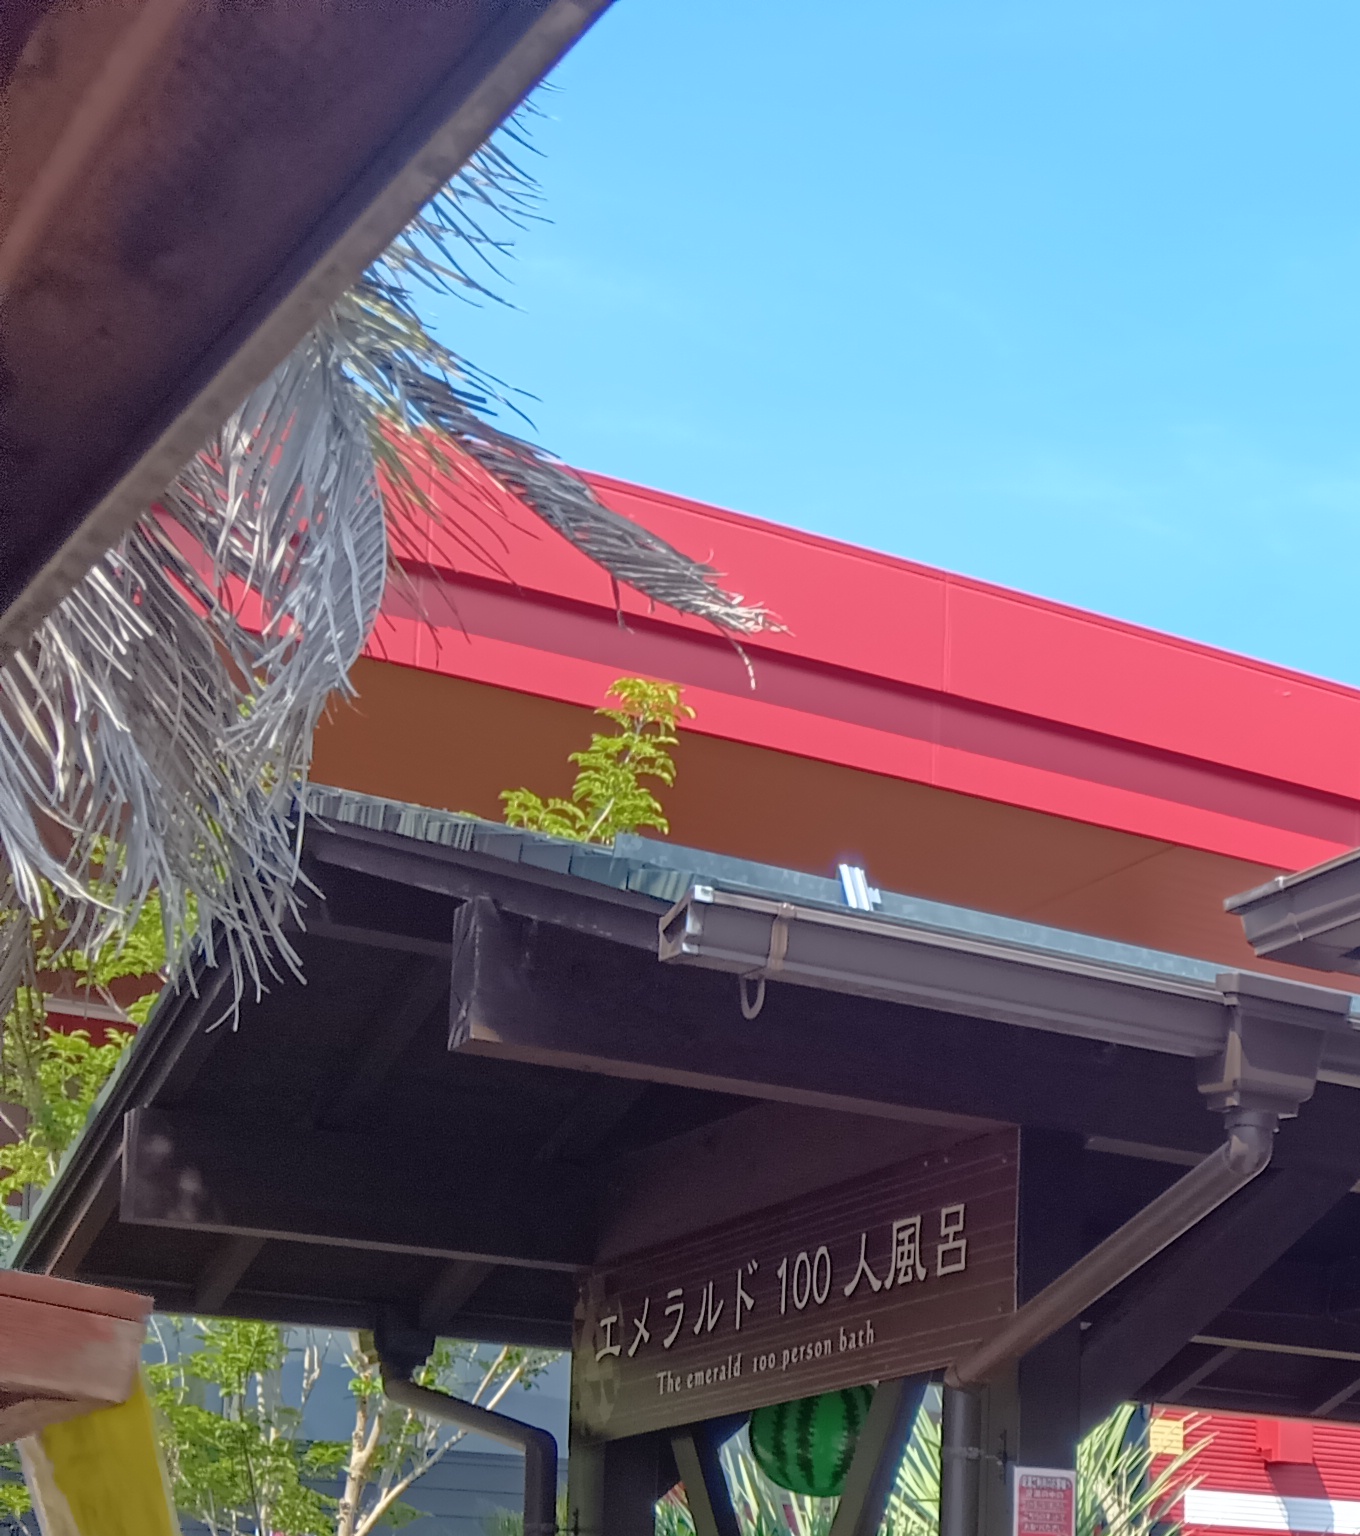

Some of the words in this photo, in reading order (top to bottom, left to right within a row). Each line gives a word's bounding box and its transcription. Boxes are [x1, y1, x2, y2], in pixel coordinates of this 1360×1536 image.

[656, 1370, 682, 1397] The
[686, 1352, 743, 1389] emerald
[752, 1353, 777, 1374] 100
[781, 1339, 833, 1372] person
[838, 1319, 876, 1353] bath
